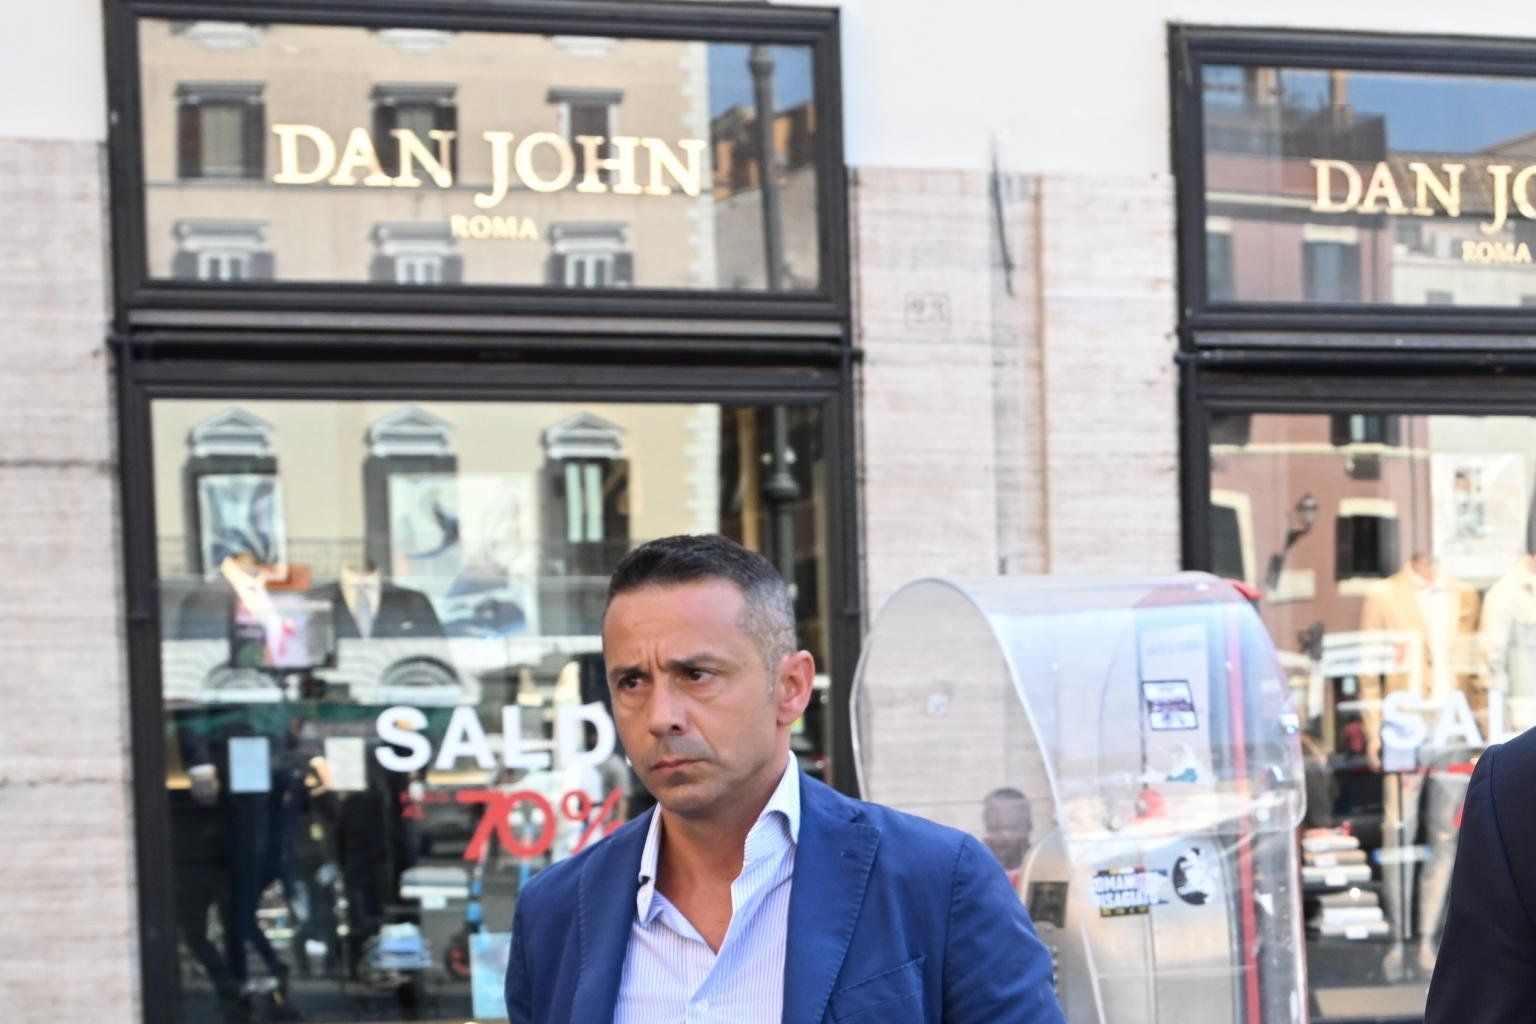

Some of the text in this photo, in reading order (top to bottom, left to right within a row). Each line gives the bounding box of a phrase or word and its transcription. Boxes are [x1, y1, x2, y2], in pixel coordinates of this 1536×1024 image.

[271, 123, 707, 209] DAN JOHN
[1309, 158, 1467, 219] DAN
[450, 213, 539, 241] ROMA
[1461, 240, 1533, 264] ROMA
[374, 702, 633, 772] SALD
